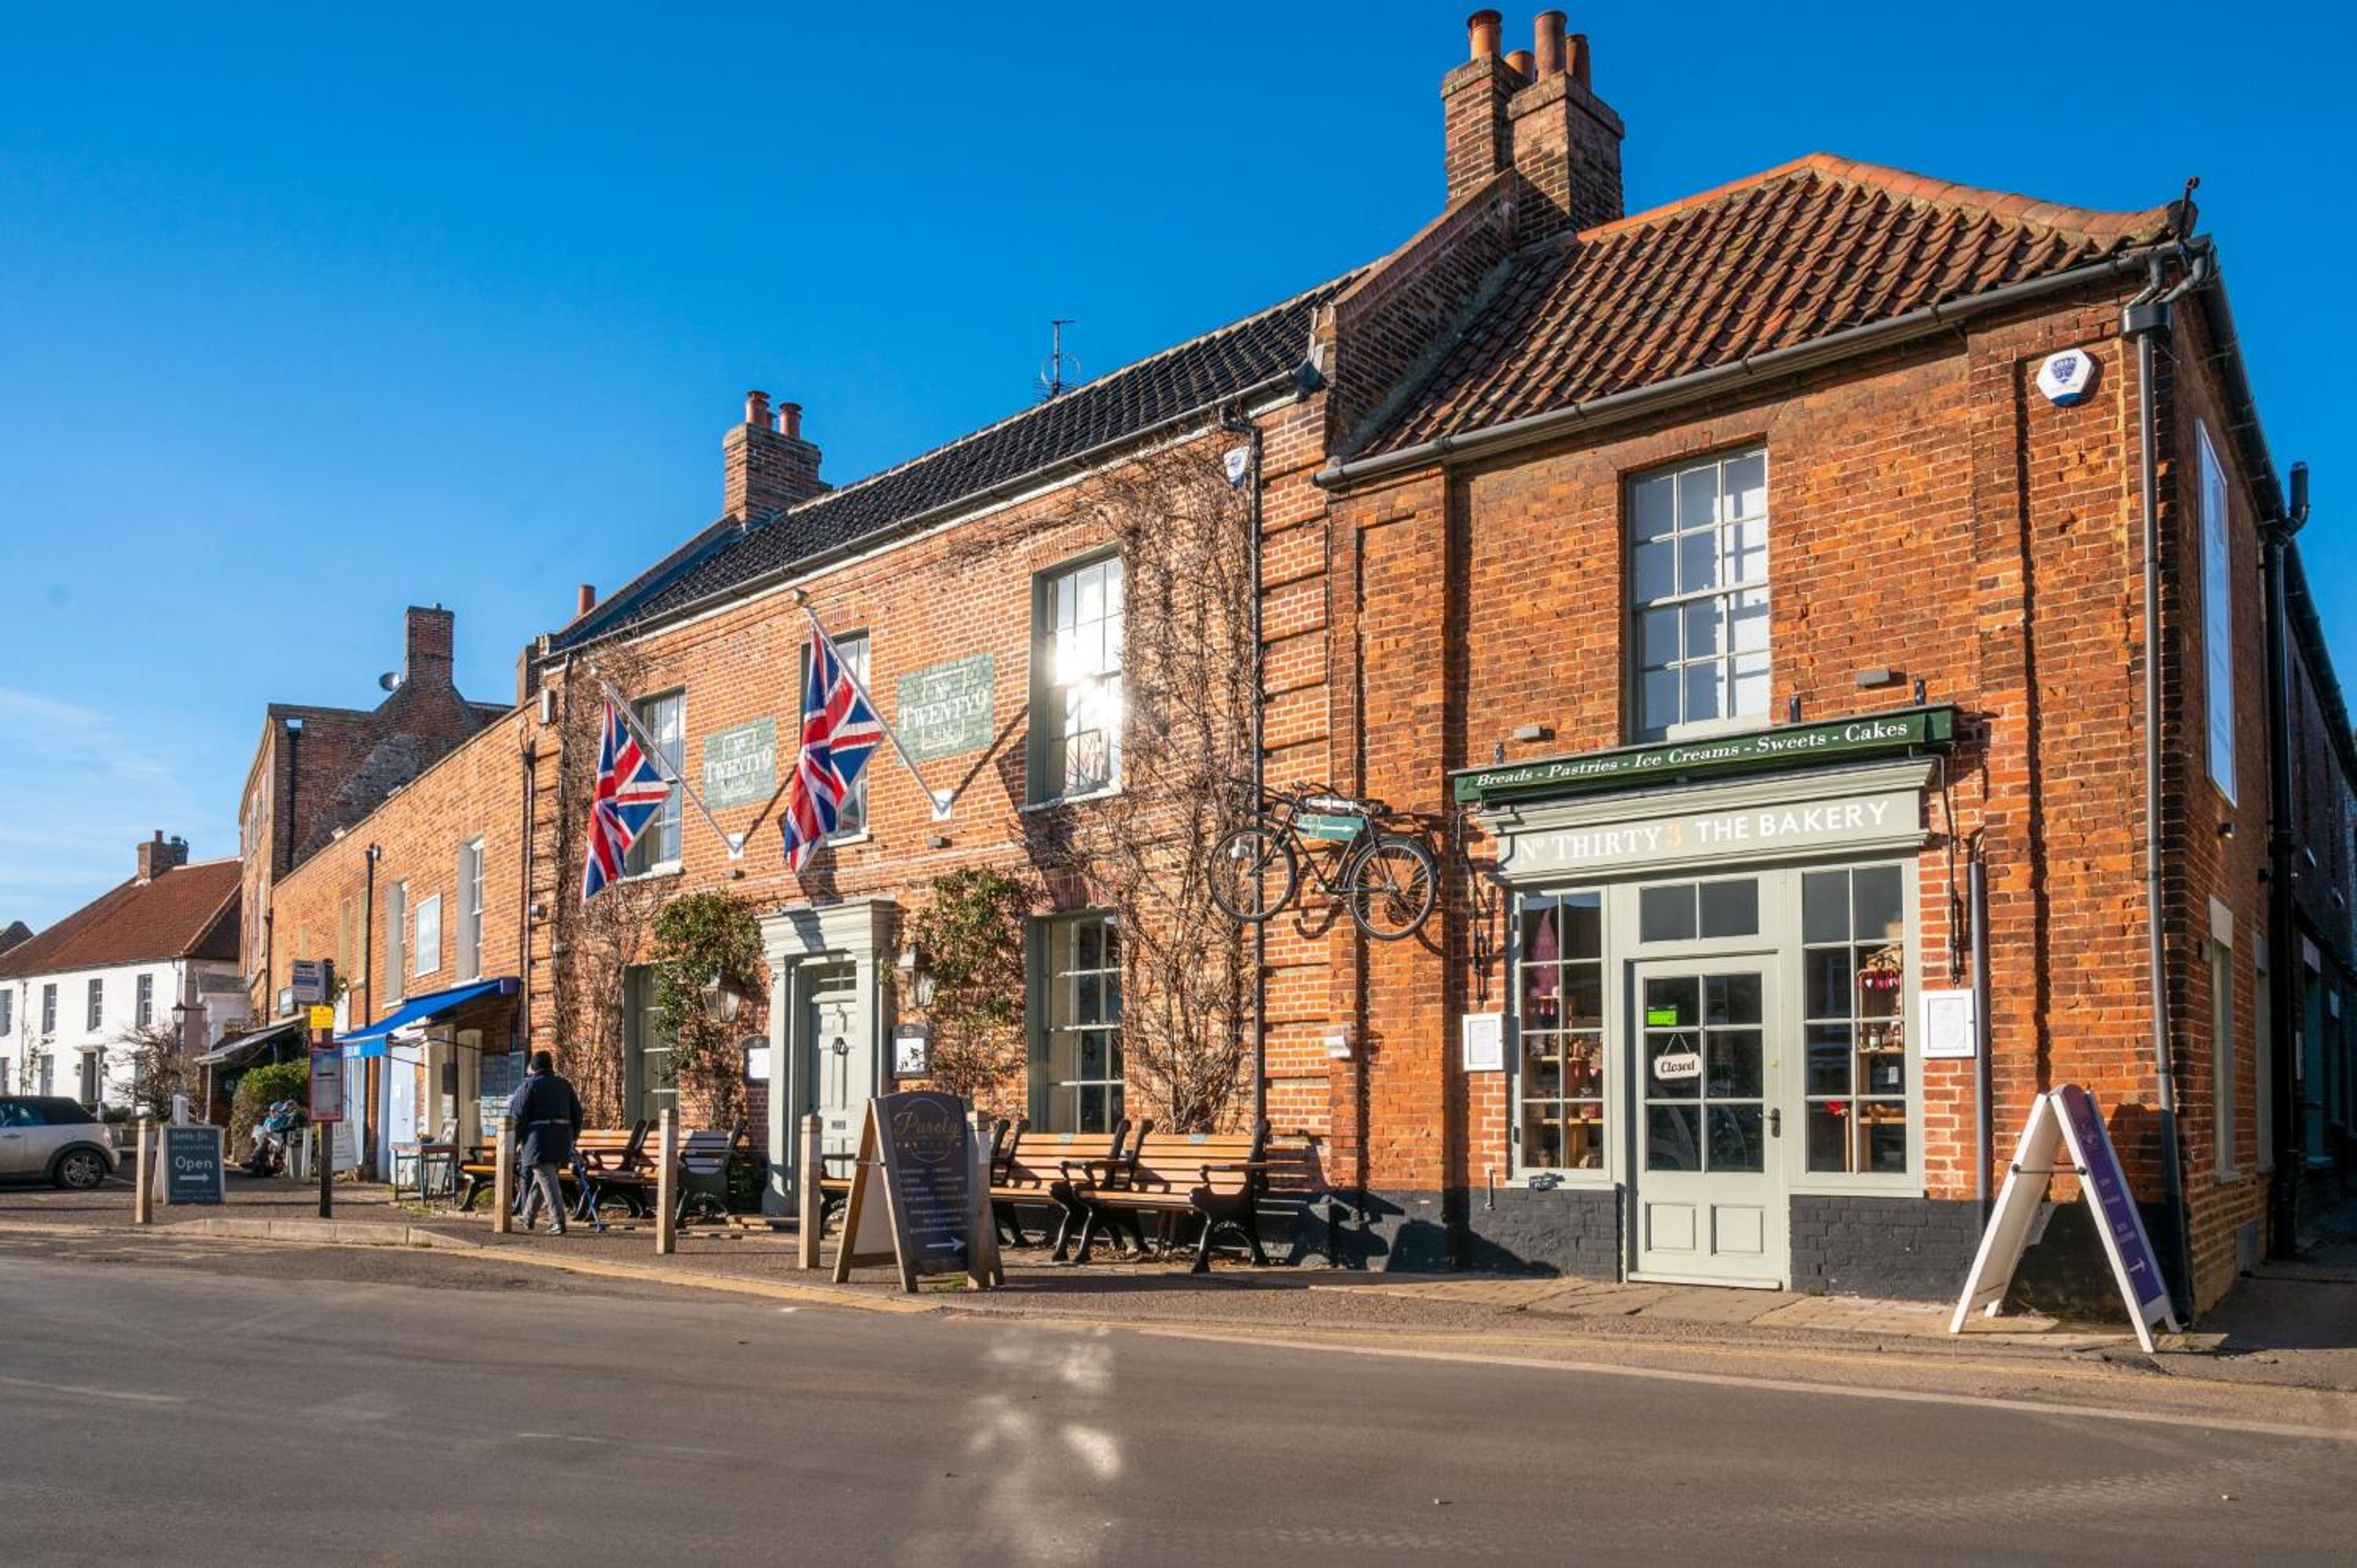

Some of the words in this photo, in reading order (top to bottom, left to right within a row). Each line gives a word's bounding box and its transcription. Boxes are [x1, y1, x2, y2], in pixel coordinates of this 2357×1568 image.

[1476, 768, 1532, 786] Breads
[1546, 760, 1618, 779] Pastries
[1633, 753, 1662, 768] Ice
[1669, 746, 1739, 764] Creams
[1756, 731, 1827, 753] Sweets
[1845, 721, 1908, 742] Cakes
[1695, 816, 1749, 843] THE
[1759, 800, 1889, 837] BAKERY
[1660, 1059, 1695, 1074] Closed
[175, 1156, 213, 1173] Open
